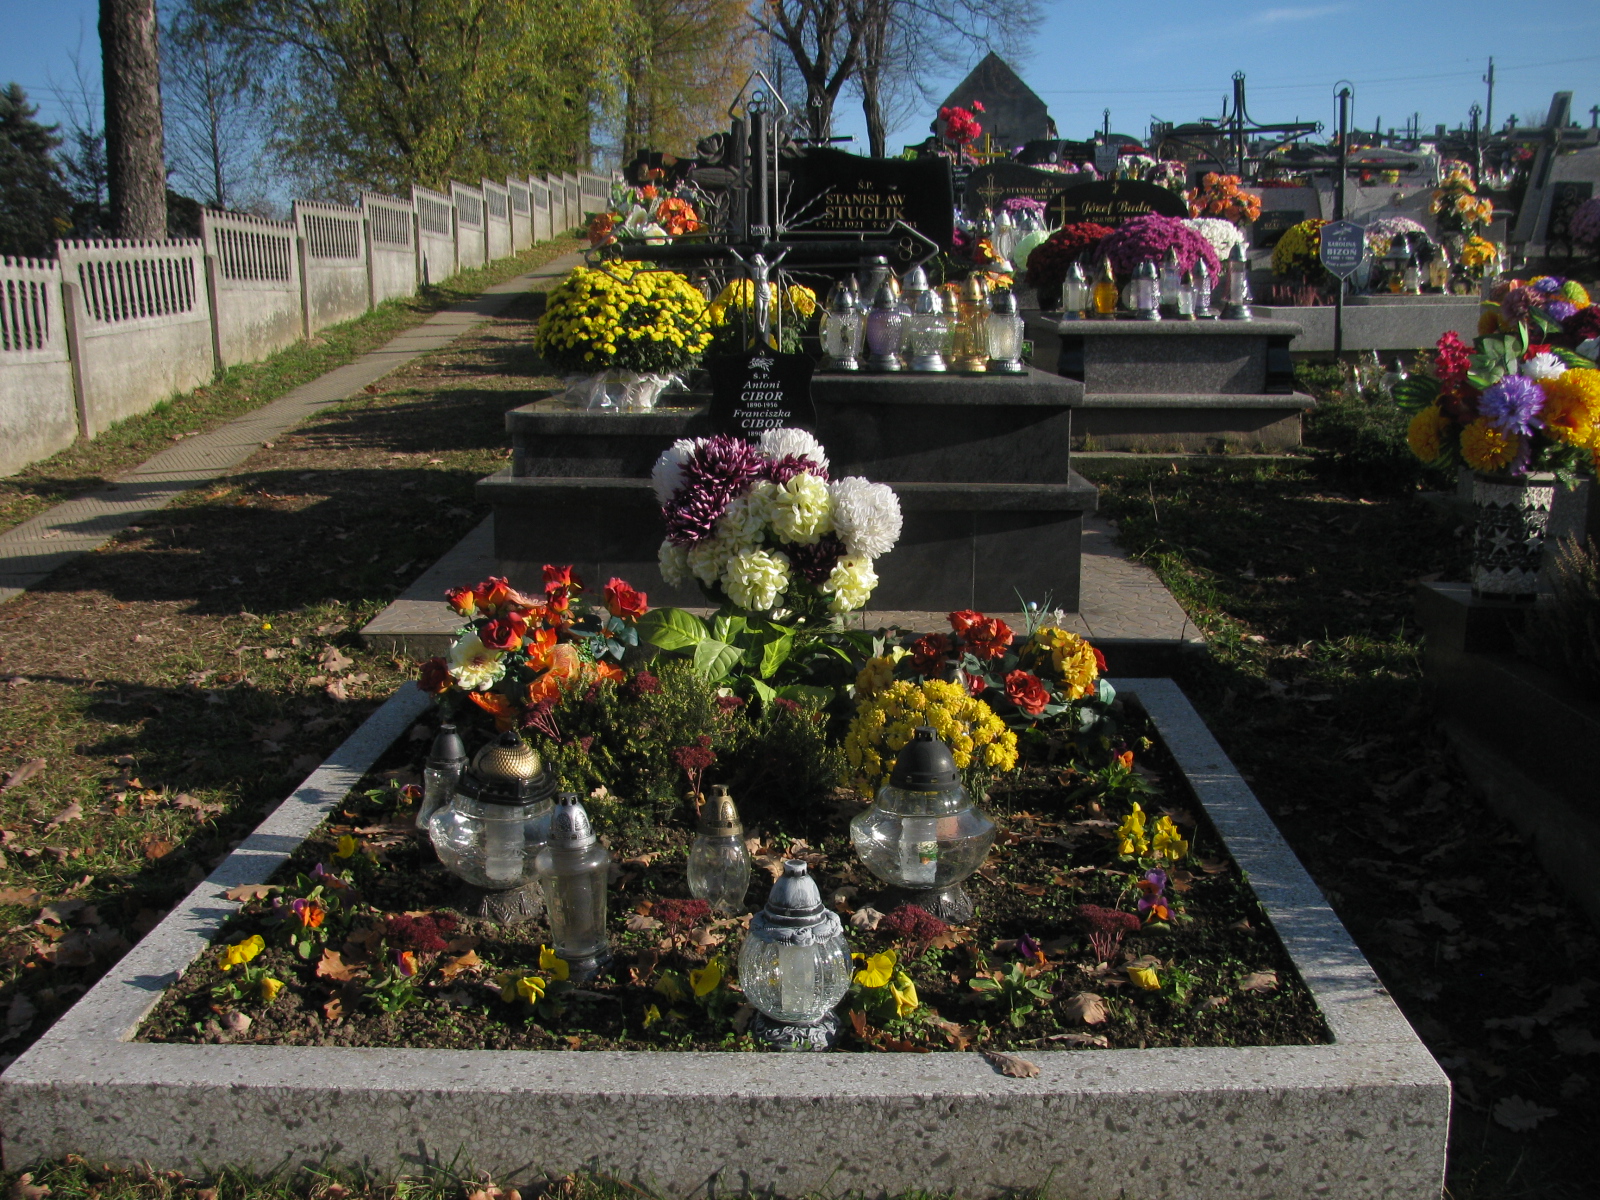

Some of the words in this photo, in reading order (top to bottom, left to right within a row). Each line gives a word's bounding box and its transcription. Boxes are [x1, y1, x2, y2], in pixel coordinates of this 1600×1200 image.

[825, 206, 906, 220] STUGLIK
[743, 380, 781, 389] Antoni
[741, 391, 783, 401] CIBOR
[733, 409, 791, 418] Franciszka
[741, 419, 783, 428] CIBOR
